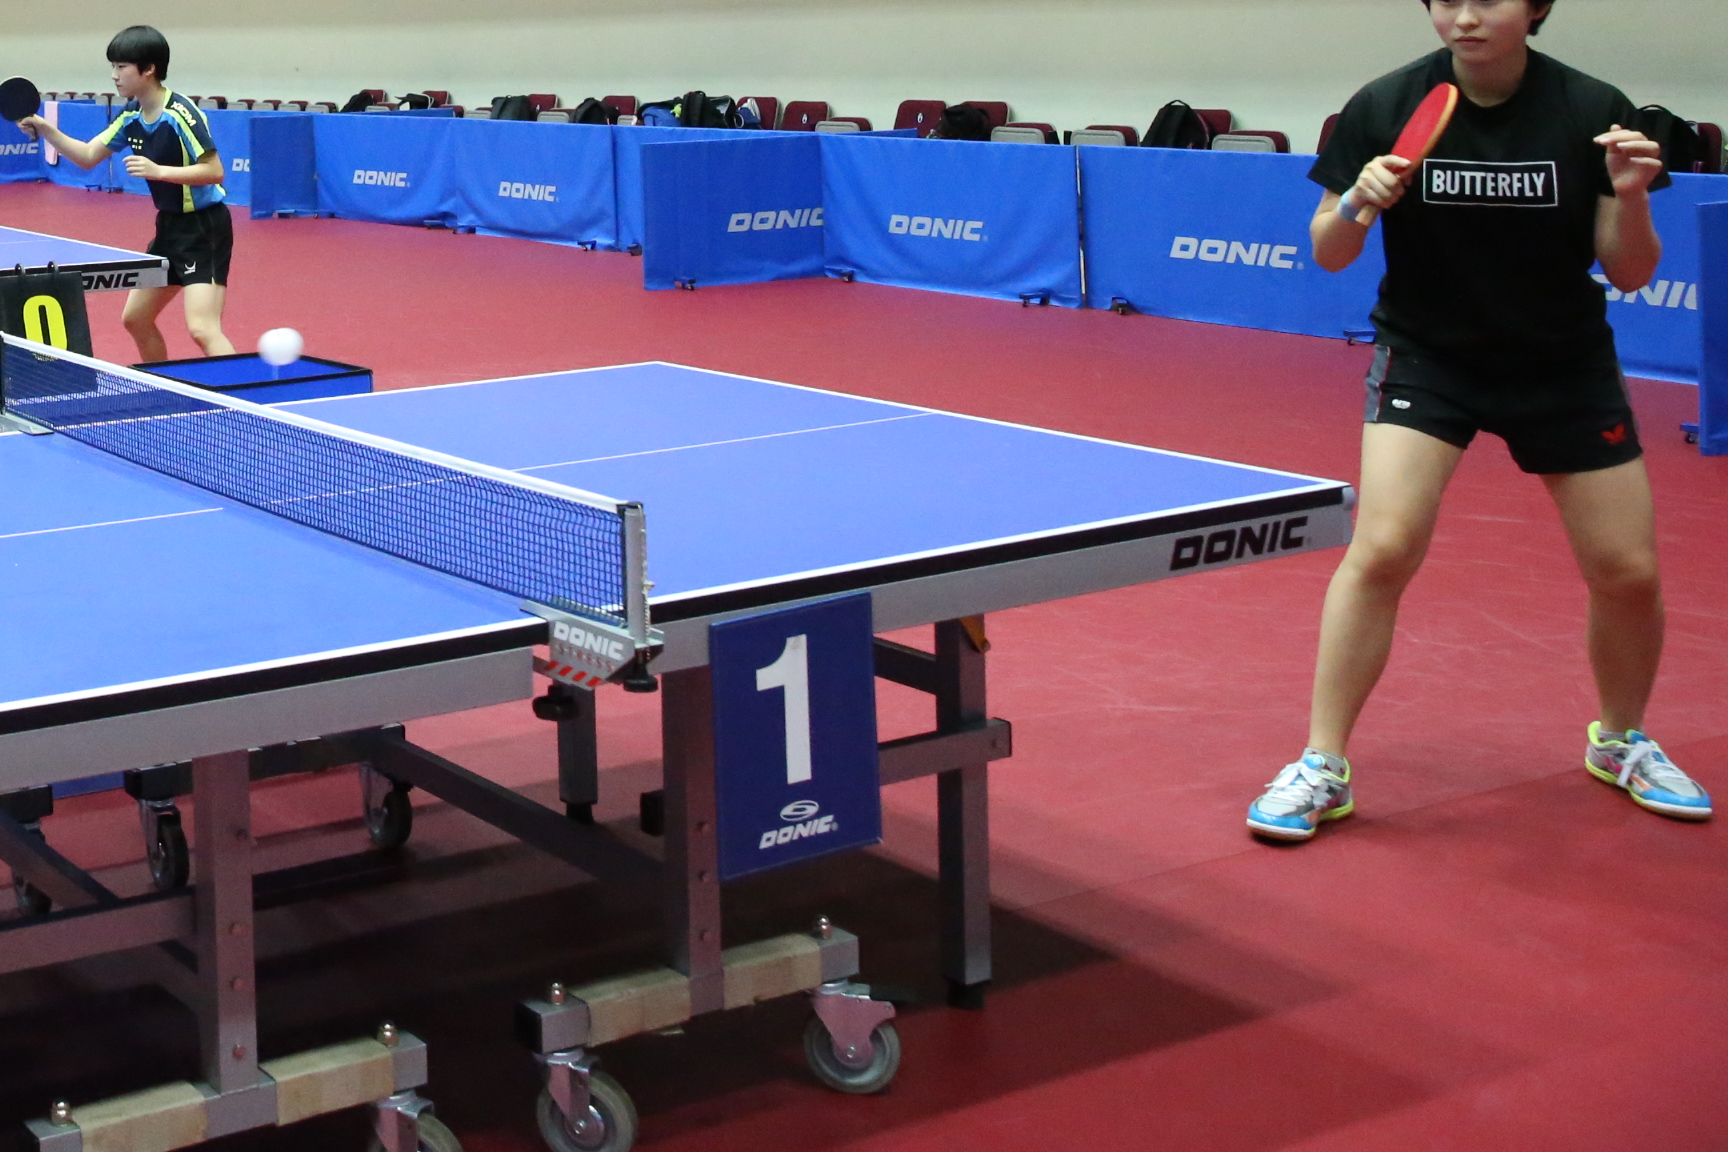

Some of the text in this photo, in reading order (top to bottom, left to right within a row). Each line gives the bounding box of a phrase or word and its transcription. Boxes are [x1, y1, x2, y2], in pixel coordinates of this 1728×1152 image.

[353, 170, 408, 187] DONIC
[499, 182, 557, 202] DONIC
[1432, 169, 1546, 197] BUTTERFLY
[889, 215, 984, 241] DONIC
[1170, 236, 1297, 269] DONIC
[23, 295, 68, 361] 0
[1170, 516, 1308, 571] DONIC
[553, 621, 624, 661] DONIC
[756, 634, 812, 785] 1
[759, 815, 834, 850] DONIC
